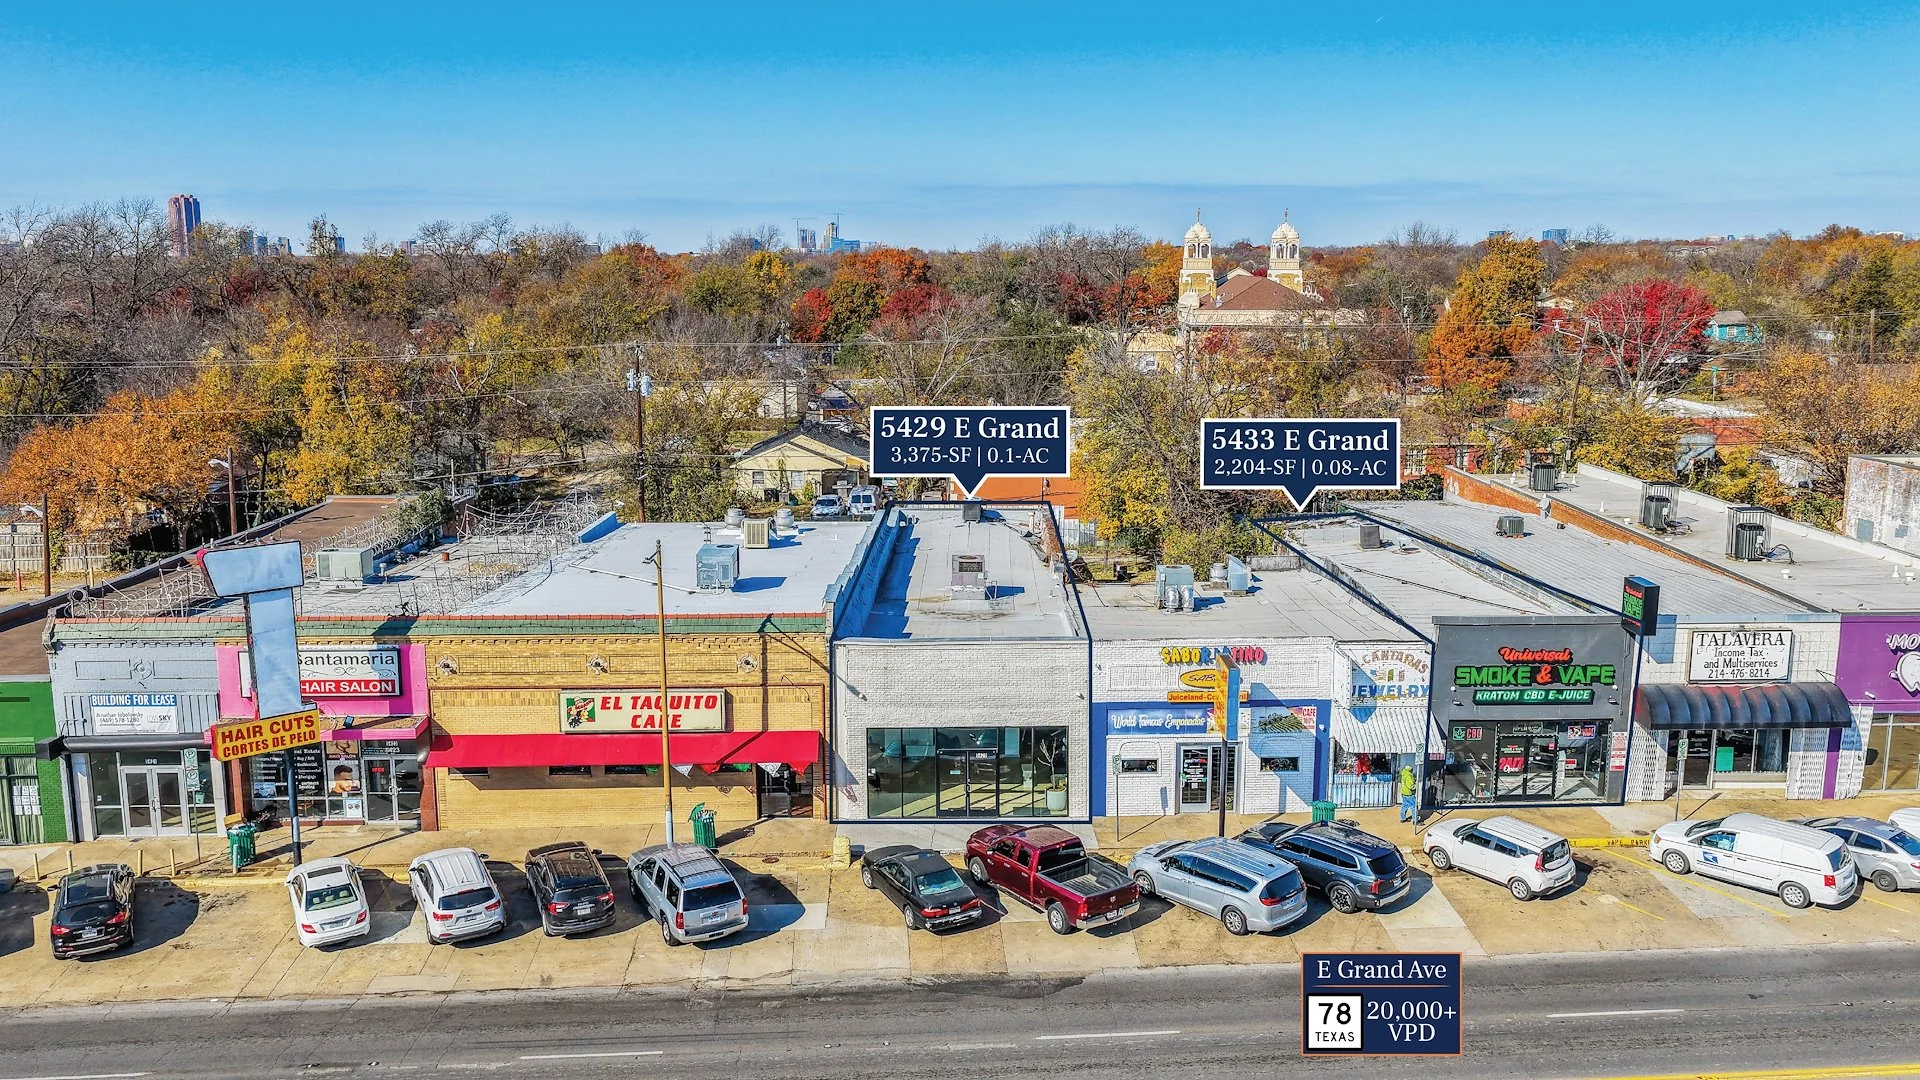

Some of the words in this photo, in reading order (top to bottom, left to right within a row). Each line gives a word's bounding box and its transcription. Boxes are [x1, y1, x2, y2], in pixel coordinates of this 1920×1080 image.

[1696, 632, 1785, 646] TALAVERA
[1160, 646, 1212, 664] SABOR
[1499, 647, 1571, 661] Universal
[1714, 647, 1745, 657] Income
[1748, 646, 1763, 657] Tax
[298, 653, 395, 665] Santamaria
[1703, 658, 1719, 668] and
[1723, 658, 1778, 668] Multiservices
[1455, 666, 1530, 684] SMOKE
[1536, 664, 1552, 684] &
[1558, 665, 1615, 684] VAPE
[1708, 668, 1770, 678] 214-476-8214
[301, 682, 336, 692] HAIR
[340, 681, 392, 692] SALON
[92, 695, 130, 705] BUILDING
[133, 695, 149, 705] FOR
[151, 694, 175, 705] LEASE
[1475, 690, 1520, 700] KRATOM
[1524, 690, 1545, 700] CBD
[1550, 690, 1591, 700] E-JUICE
[600, 696, 623, 710] EL
[221, 725, 264, 744] HAIR
[269, 715, 315, 735] CUTS
[1466, 728, 1481, 738] CBD
[223, 740, 269, 758] CORTES
[272, 736, 286, 748] DE
[290, 730, 316, 745] PELO
